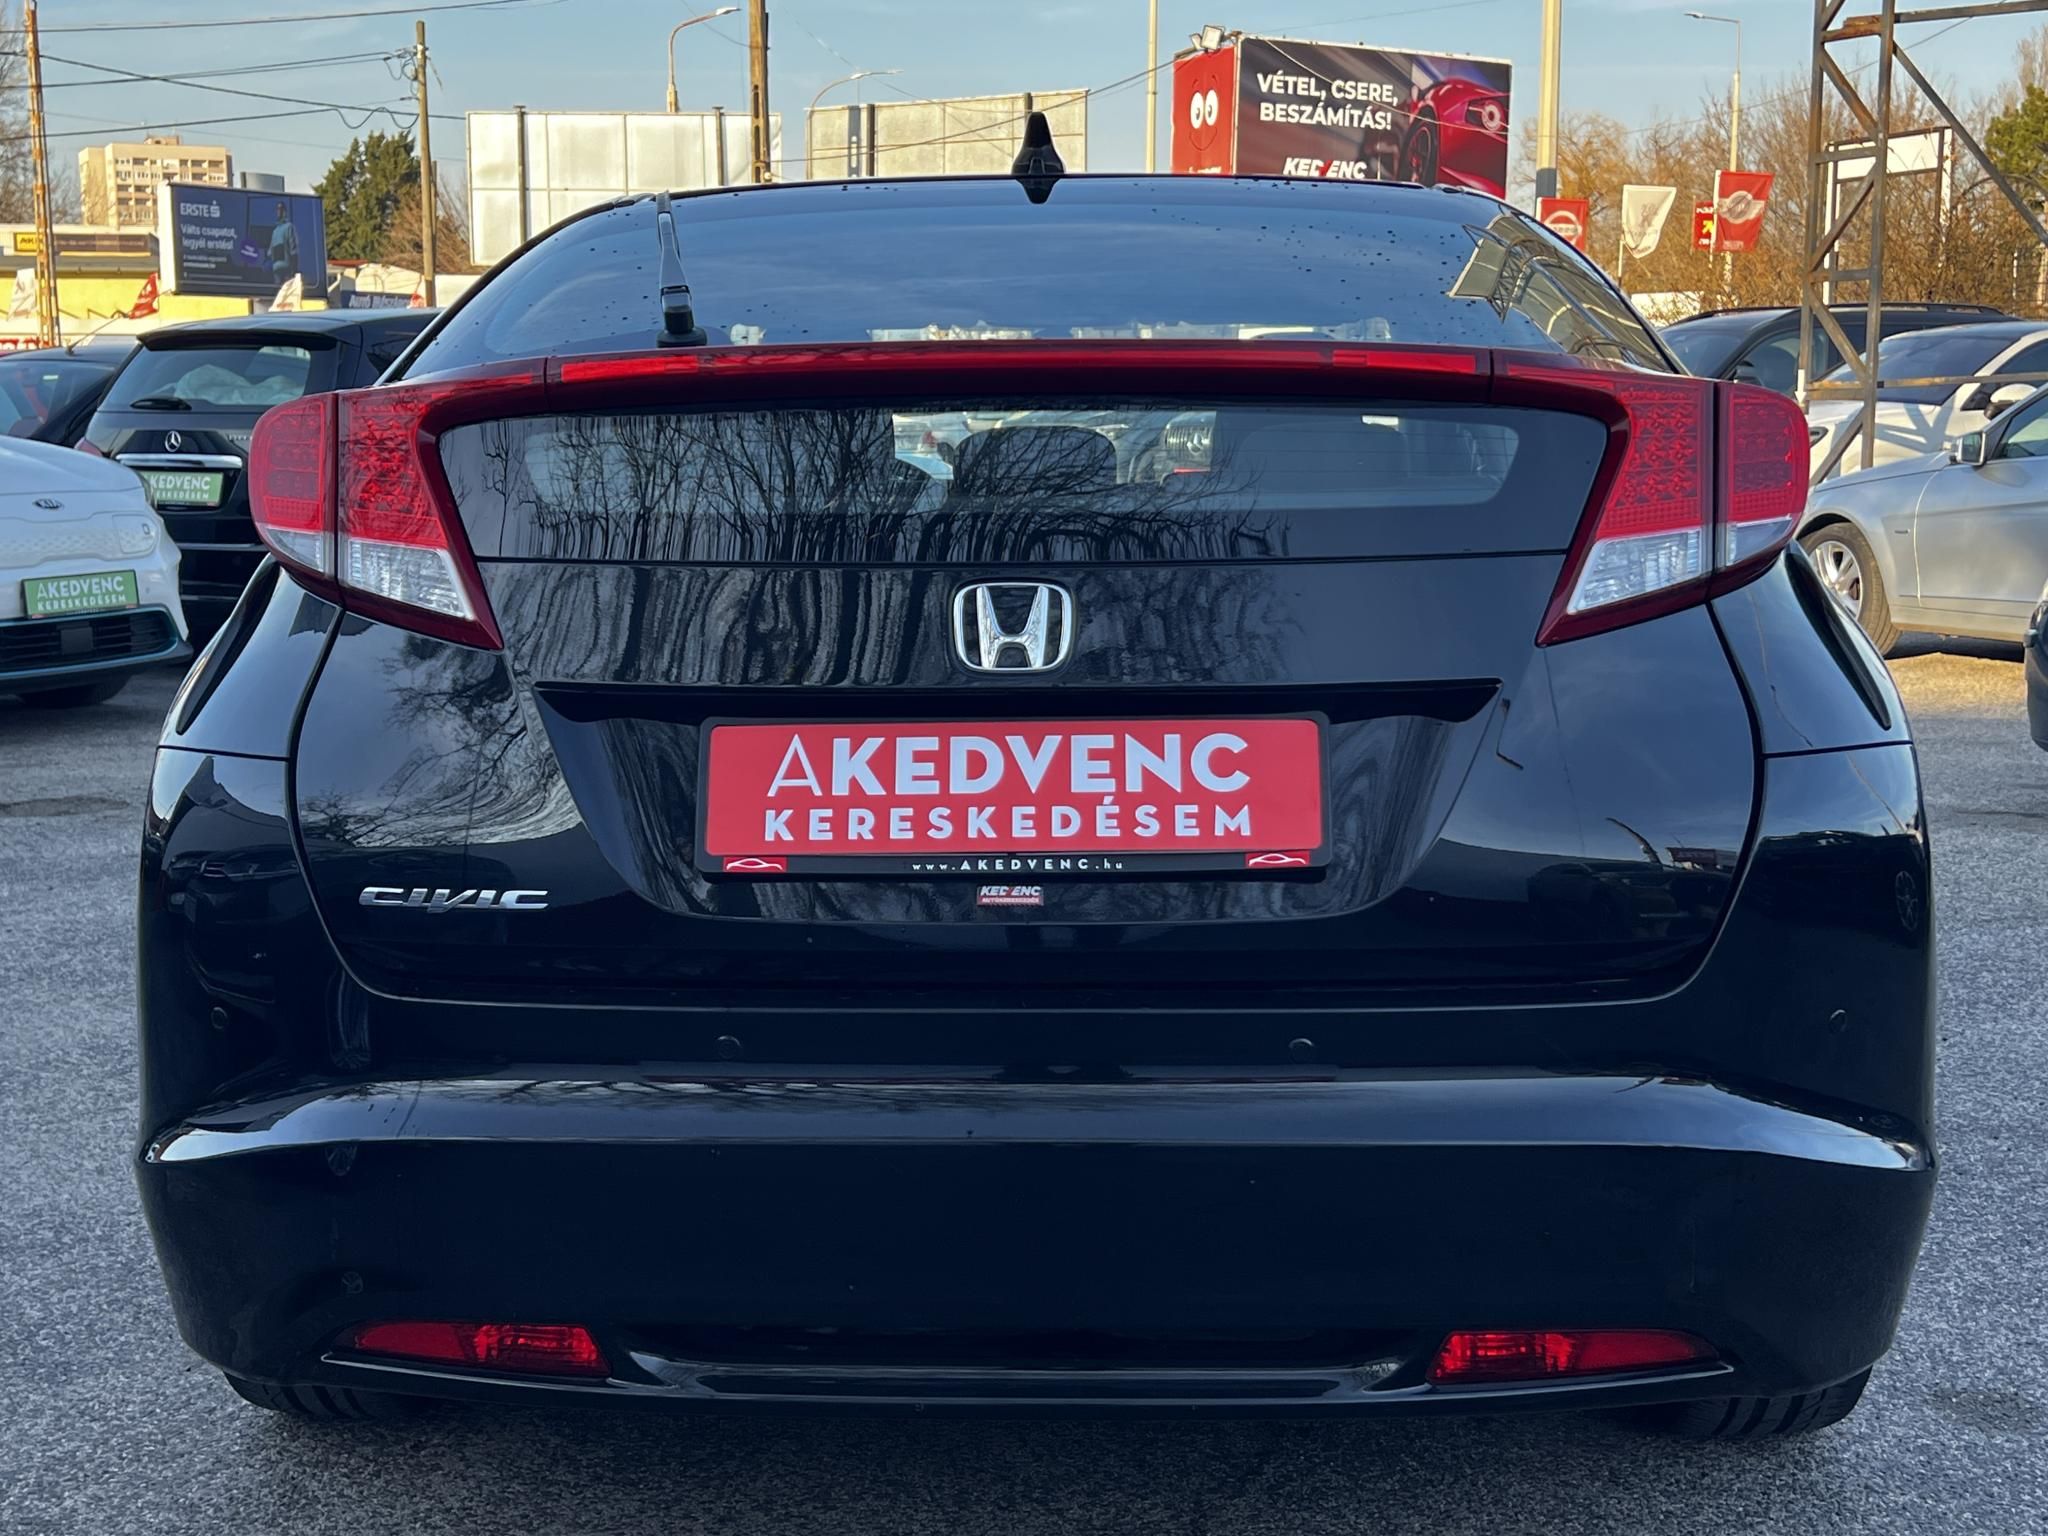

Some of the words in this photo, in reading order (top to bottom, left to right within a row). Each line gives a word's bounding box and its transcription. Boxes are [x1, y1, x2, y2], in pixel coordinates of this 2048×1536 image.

[1257, 70, 1327, 100] VÉTEL,
[1331, 80, 1398, 106] CSERE,
[1260, 102, 1392, 130] BESZÁMÍTÁS!
[180, 202, 210, 217] ERSTE
[766, 732, 1251, 797] AKEDVENC
[764, 796, 1252, 842] KERESKEDÉSEM
[912, 858, 1123, 871] www.AKEDVENC.hu
[359, 886, 549, 913] CIVIC
